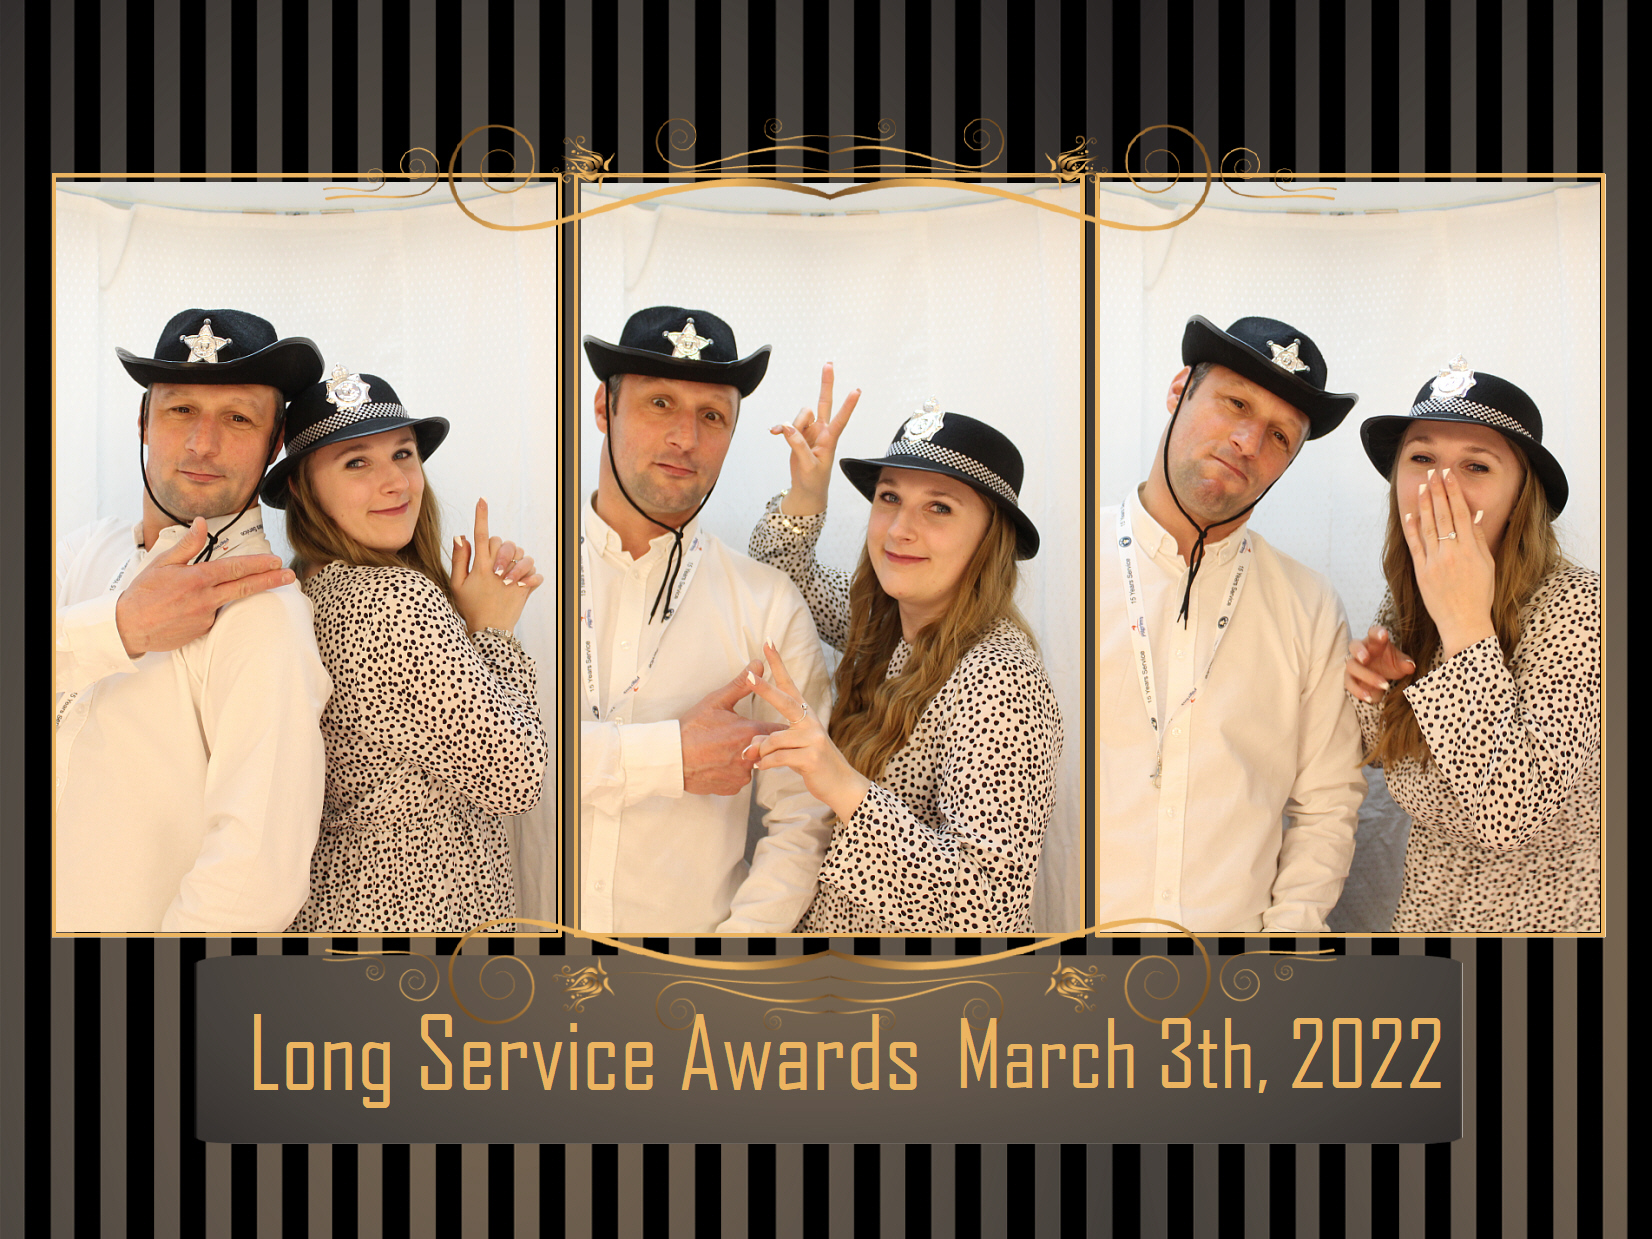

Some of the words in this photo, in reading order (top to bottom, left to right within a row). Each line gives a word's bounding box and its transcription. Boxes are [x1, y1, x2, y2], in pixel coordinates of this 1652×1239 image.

[1130, 596, 1137, 604] 15
[1140, 651, 1148, 675] Service
[589, 684, 595, 692] 15
[1143, 676, 1151, 695] Years
[1147, 696, 1153, 704] 15
[60, 699, 73, 713] Years
